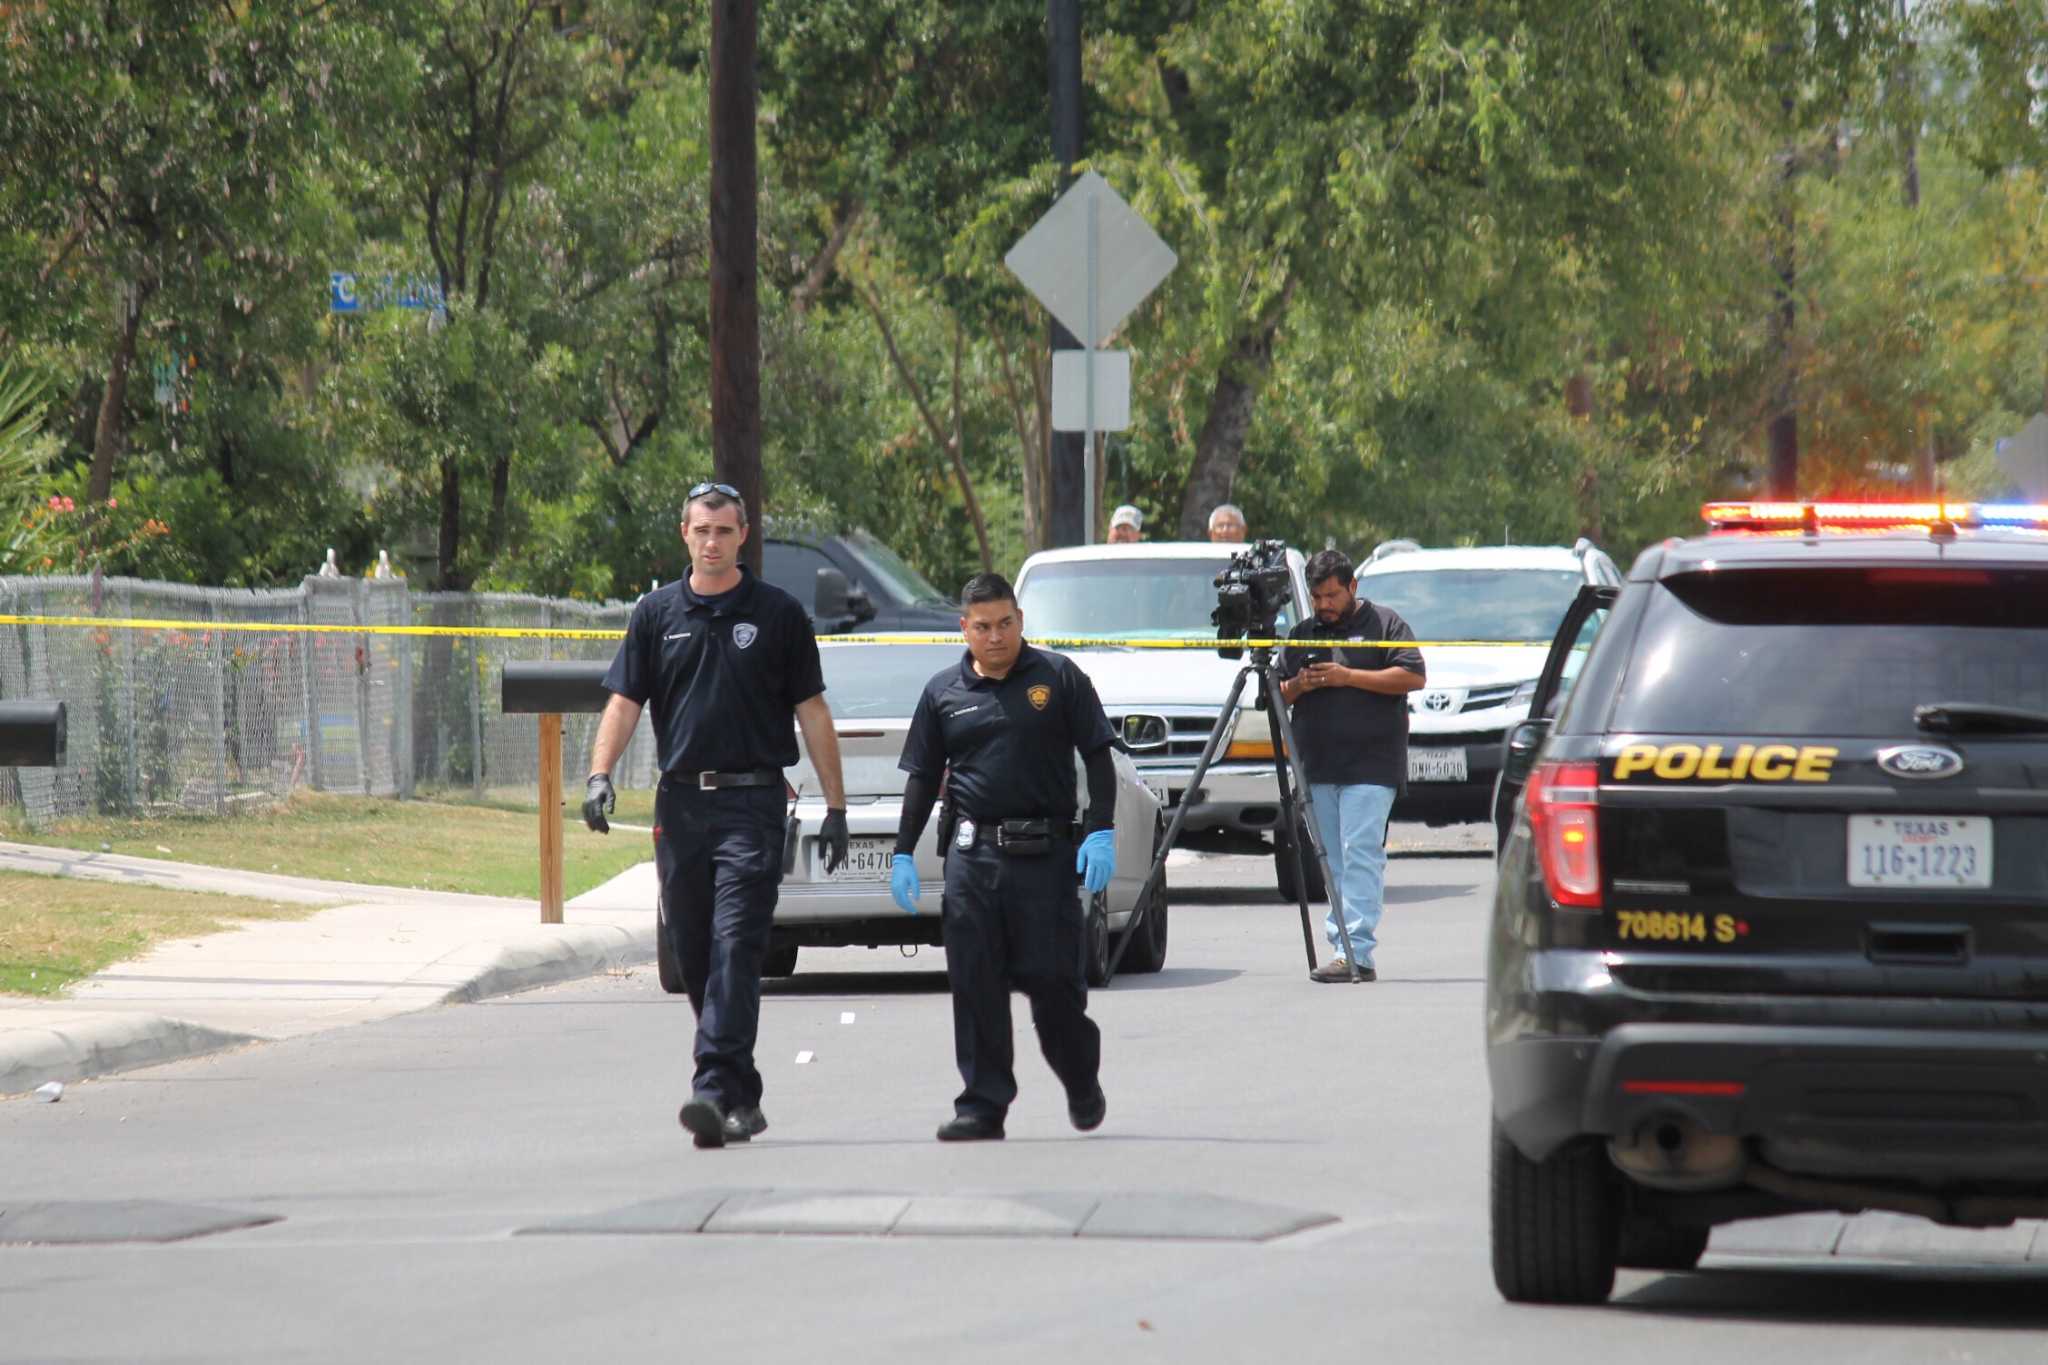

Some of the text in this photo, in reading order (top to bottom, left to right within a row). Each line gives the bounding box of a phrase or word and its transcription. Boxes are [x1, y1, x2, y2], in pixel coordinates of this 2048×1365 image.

[1613, 744, 1839, 781] POLICE
[1896, 752, 1944, 770] Ford
[1893, 821, 1950, 836] TEXAS
[1714, 914, 1736, 942] S
